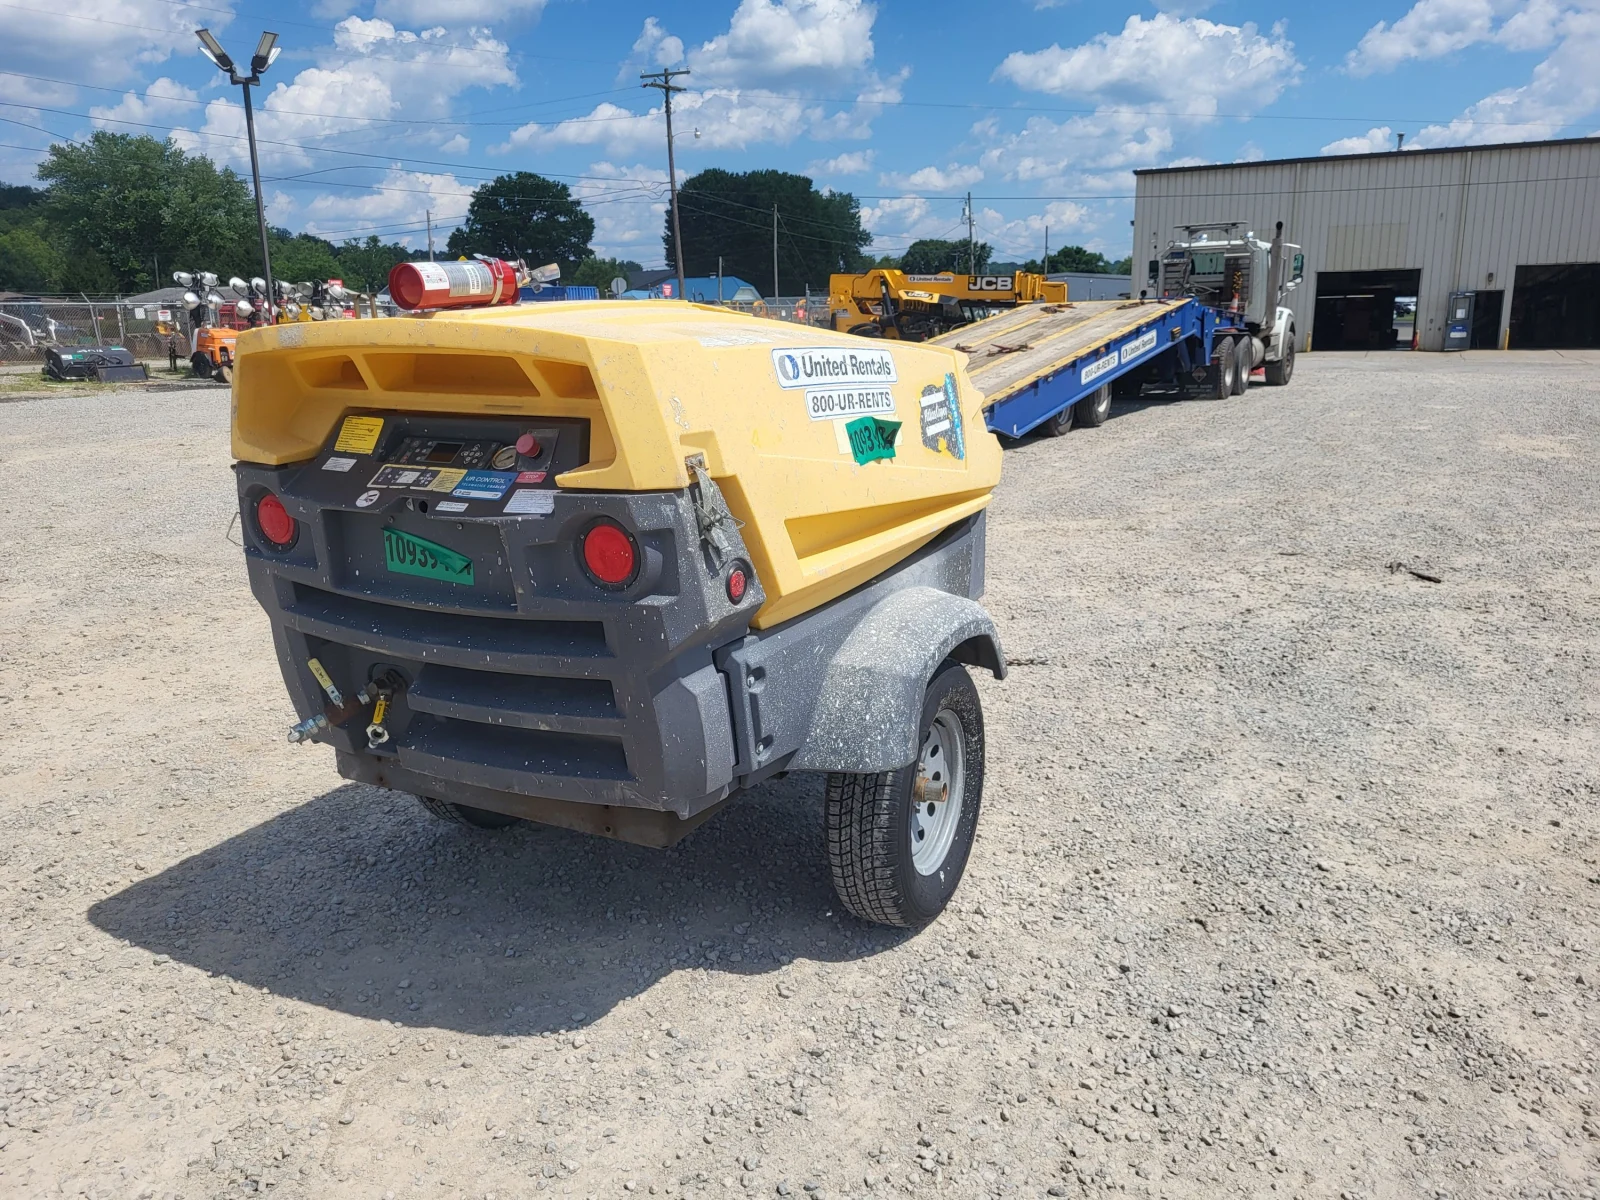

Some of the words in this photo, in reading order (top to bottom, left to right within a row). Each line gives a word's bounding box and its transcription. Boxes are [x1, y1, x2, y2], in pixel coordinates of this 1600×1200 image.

[969, 277, 1012, 290] JCB
[802, 354, 848, 378] United
[850, 353, 891, 377] Rentals
[1084, 355, 1116, 380] 800-UR-RENTS
[812, 391, 891, 413] 800-UR-RENTS
[475, 476, 506, 484] CONTROL
